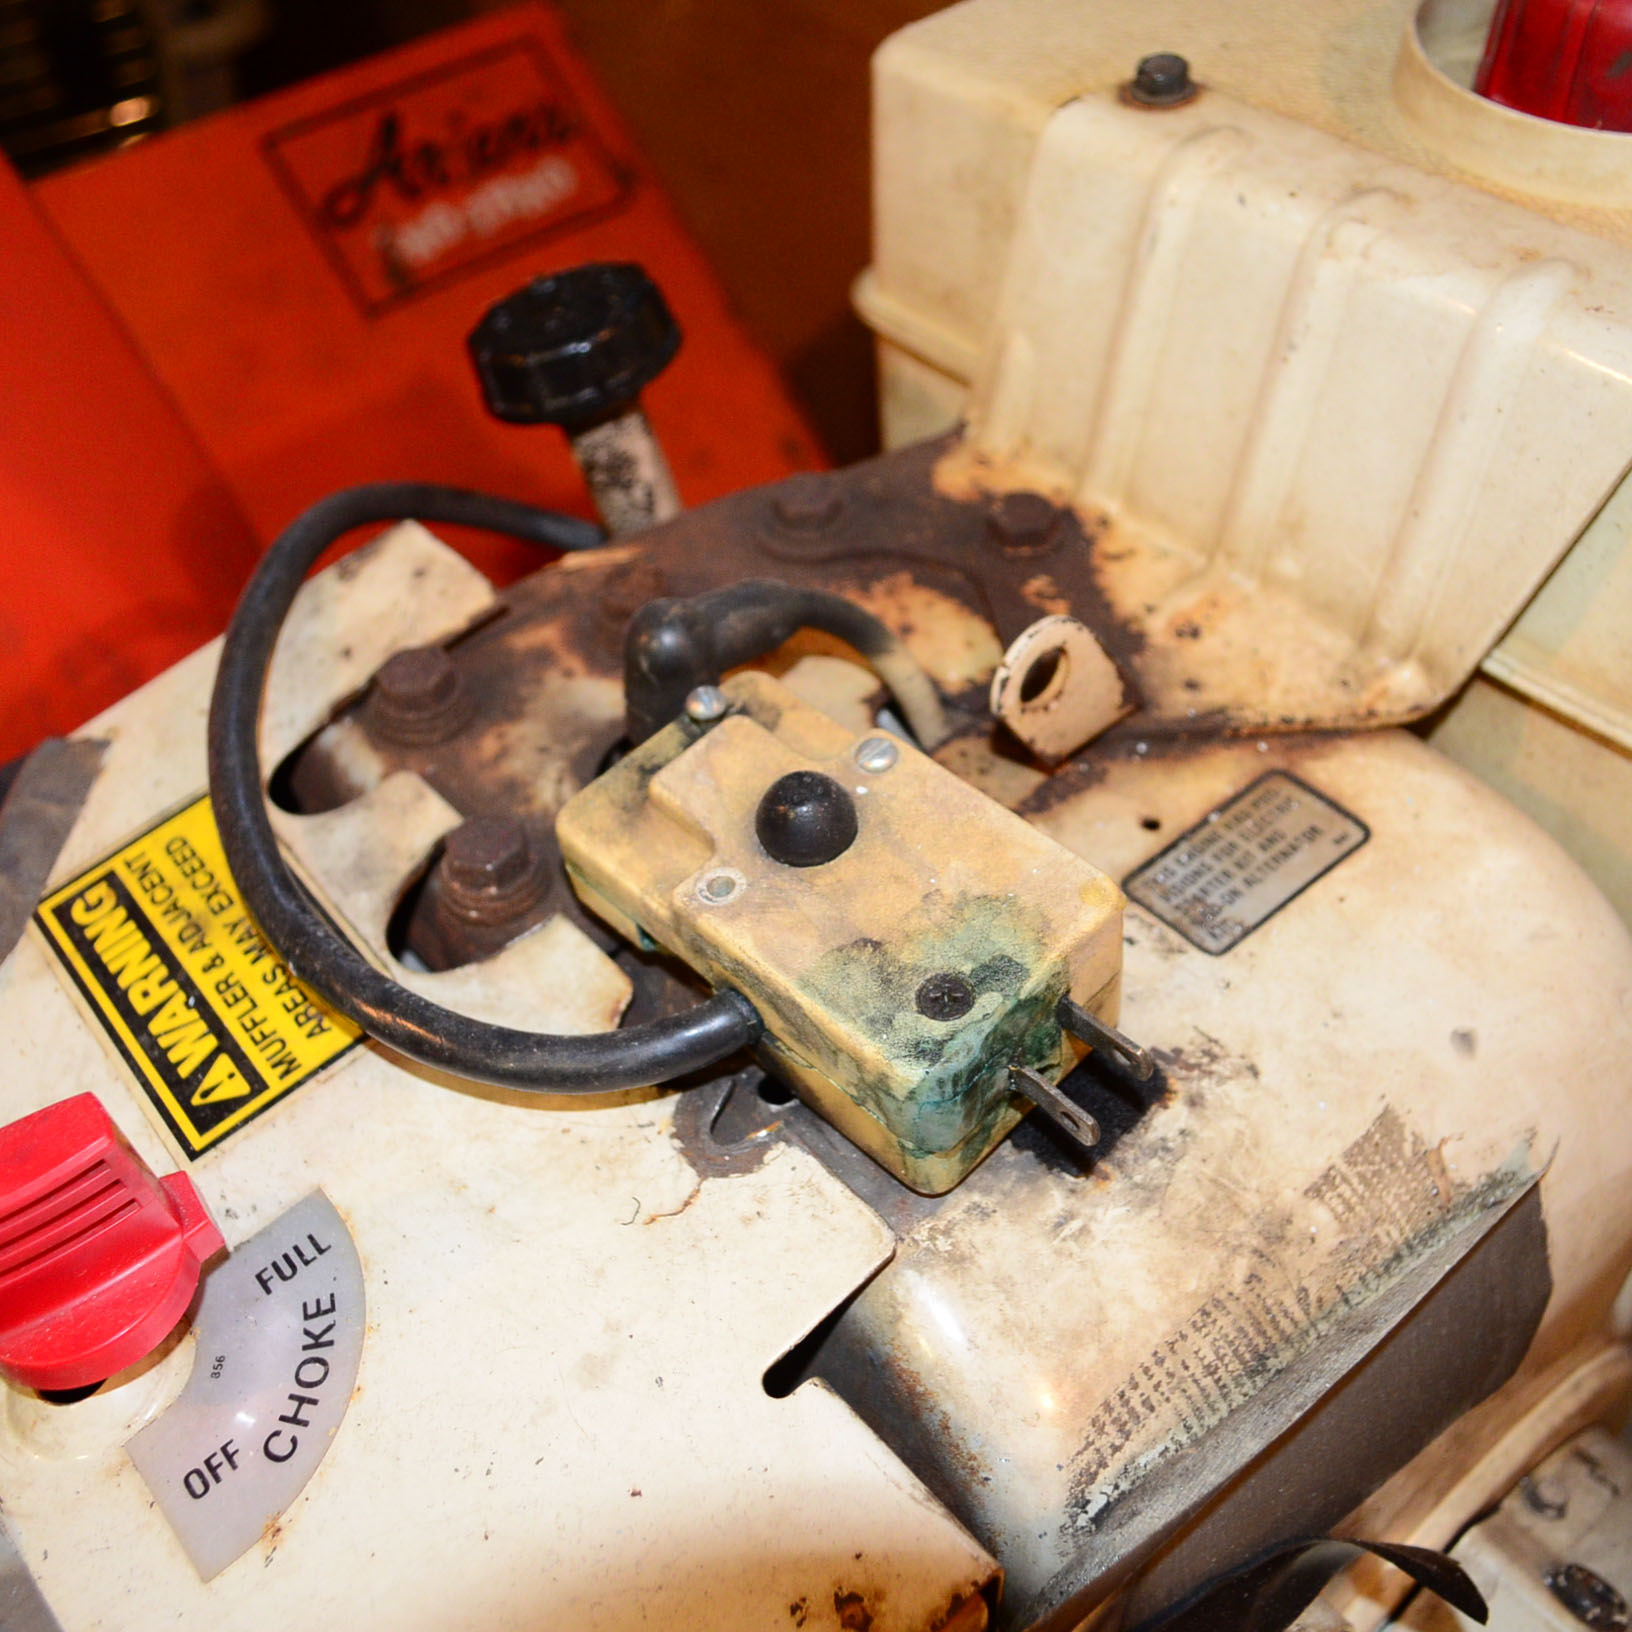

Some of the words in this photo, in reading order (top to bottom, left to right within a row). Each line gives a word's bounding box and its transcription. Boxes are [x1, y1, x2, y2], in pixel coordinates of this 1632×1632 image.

[124, 852, 207, 954] ADJACENT
[165, 836, 234, 917] EXCEED
[201, 956, 226, 974] &
[223, 914, 268, 965] MAY
[70, 880, 219, 1080] WARNING
[262, 963, 332, 1039] AREAS
[214, 971, 303, 1081] MUFFLER
[255, 1234, 332, 1295] FULL
[263, 1292, 336, 1463] CHOKE
[183, 1439, 240, 1500] OFF
